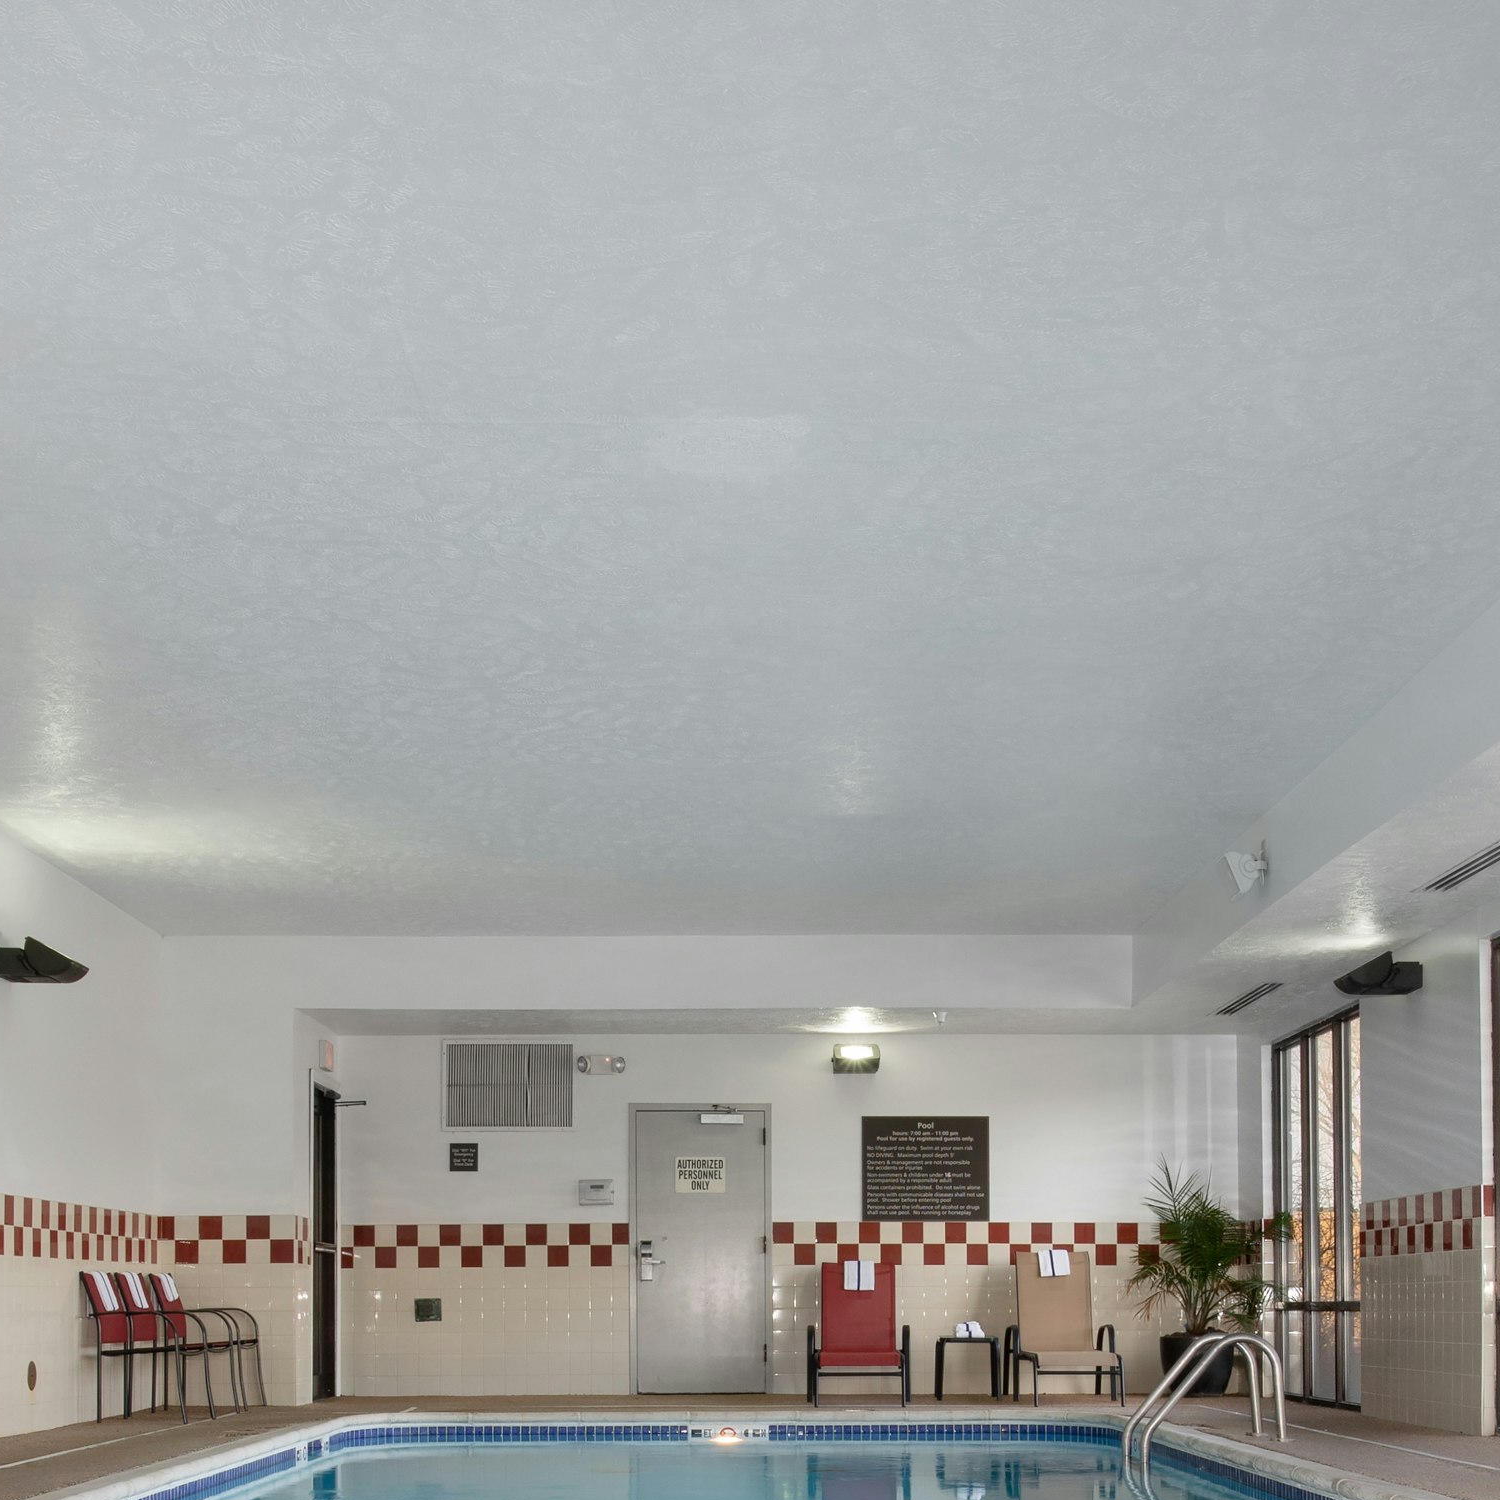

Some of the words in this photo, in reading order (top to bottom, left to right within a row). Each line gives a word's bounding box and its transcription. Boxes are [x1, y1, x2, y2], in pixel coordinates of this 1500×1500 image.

[677, 1160, 724, 1169] AUTHORIZED
[678, 1170, 723, 1180] PERSONNEL
[692, 1180, 710, 1190] ONLY
